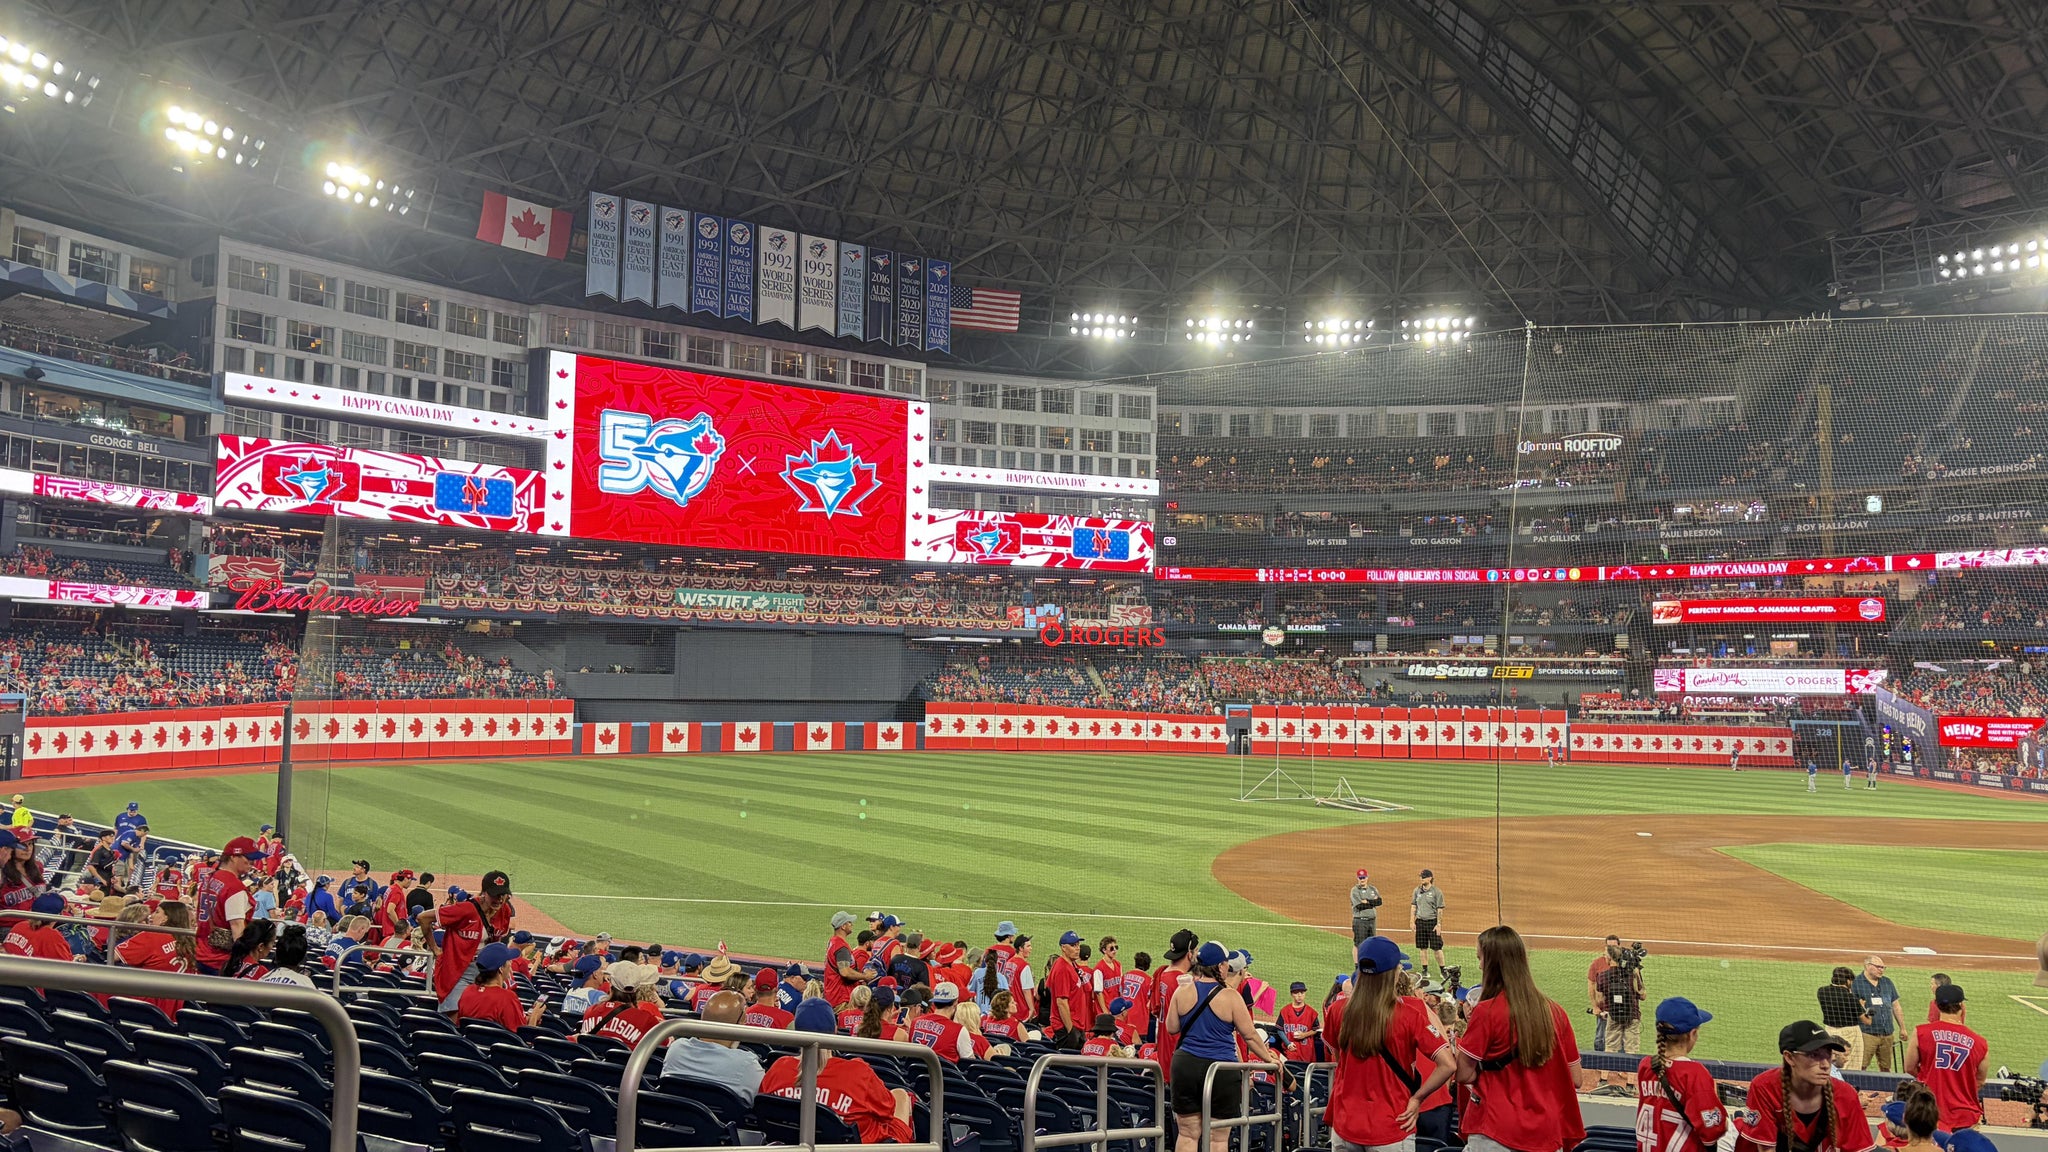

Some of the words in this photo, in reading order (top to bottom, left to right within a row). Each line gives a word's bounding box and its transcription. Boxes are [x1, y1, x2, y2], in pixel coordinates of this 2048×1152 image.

[594, 219, 616, 232] 1985
[629, 226, 651, 238] 1989
[592, 239, 616, 249] LEAGUE
[665, 233, 684, 246] 1991
[698, 239, 719, 252] 1992
[592, 247, 616, 259] EAST
[628, 246, 651, 256] LEAGUE
[662, 252, 686, 262] LEAGUE
[730, 245, 750, 258] 1993
[591, 257, 615, 267] CHAMPS
[627, 254, 650, 266] EAST
[662, 260, 685, 271] EAST
[697, 258, 719, 269] LEAGUE
[763, 252, 792, 270] 1992
[627, 264, 651, 273] CHAMPS
[662, 270, 686, 279] CHAMPS
[696, 266, 719, 278] EAST
[729, 264, 750, 274] LEAGUE
[804, 260, 833, 277] 1993
[843, 266, 862, 279] 2015
[696, 276, 718, 286] CHAMPS
[729, 272, 750, 284] EAST
[762, 269, 793, 283] WORLD
[871, 272, 890, 284] 2016
[728, 281, 750, 291] CHAMPS
[762, 279, 793, 293] SERIES
[803, 276, 833, 290] WORLD
[930, 283, 948, 294] 2025
[696, 288, 718, 300] ALCS
[762, 290, 792, 301] CHAMPIONS
[803, 287, 833, 300] SERIES
[871, 285, 891, 296] ALDS
[901, 284, 919, 295] 2016
[696, 298, 718, 308] CHAMPS
[728, 294, 750, 305] ALCS
[802, 297, 833, 308] CHAMPIONS
[842, 293, 861, 303] EAST
[728, 304, 749, 313] CHAMPS
[901, 299, 920, 310] 2020
[929, 300, 947, 310] LEAGUE
[842, 313, 861, 324] ALDS
[900, 312, 920, 324] 2022
[929, 307, 947, 318] EAST
[900, 327, 920, 338] 2023
[929, 328, 947, 339] ALCS
[342, 394, 383, 416] HAPPY
[384, 401, 432, 420] CANADA
[432, 408, 454, 422] DAY
[90, 434, 133, 450] GEORGE
[138, 442, 160, 453] BELL
[1517, 440, 1562, 455] Corona
[1564, 438, 1622, 452] ROOFTOP
[1942, 466, 1978, 478] JACKIE
[1981, 463, 2037, 476] ROBINSON
[1006, 472, 1034, 484] HAPPY
[1036, 474, 1070, 487] CANADA
[1070, 478, 1087, 488] DAY
[390, 480, 408, 493] VS
[1978, 510, 2032, 520] BAUTISTA
[1796, 523, 1816, 532] ROY
[1819, 520, 1869, 531] HALLADAY
[1549, 534, 1581, 542] GILLICK
[1660, 530, 1681, 539] PAUL
[1683, 528, 1723, 538] BEESTON
[1042, 535, 1054, 546] VS
[1367, 571, 1396, 581] FOLLOW
[1397, 570, 1441, 581] @BLUEJAYS
[1442, 571, 1453, 580] ON
[1455, 571, 1479, 580] SOCIAL
[1690, 564, 1723, 576] HAPPY
[1725, 563, 1772, 575] CANADA
[1773, 563, 1789, 573] DAY
[228, 577, 420, 616] Budweiser
[772, 597, 803, 606] FLIGHT
[1071, 626, 1166, 648] ROGERS
[1408, 664, 1488, 678] theScore
[1498, 667, 1532, 677] BET
[1798, 677, 1838, 685] ROGERS
[1892, 707, 1898, 721] TO
[1906, 712, 1926, 737] HEINZ
[1943, 724, 1983, 738] HEINZ
[1123, 981, 1141, 999] 57
[915, 1020, 945, 1034] BIEBER
[912, 1031, 938, 1048] 57
[1932, 1030, 1974, 1049] BIEBER
[1935, 1042, 1970, 1072] 57
[832, 1094, 853, 1113] JR
[1636, 1103, 1694, 1152] 47
